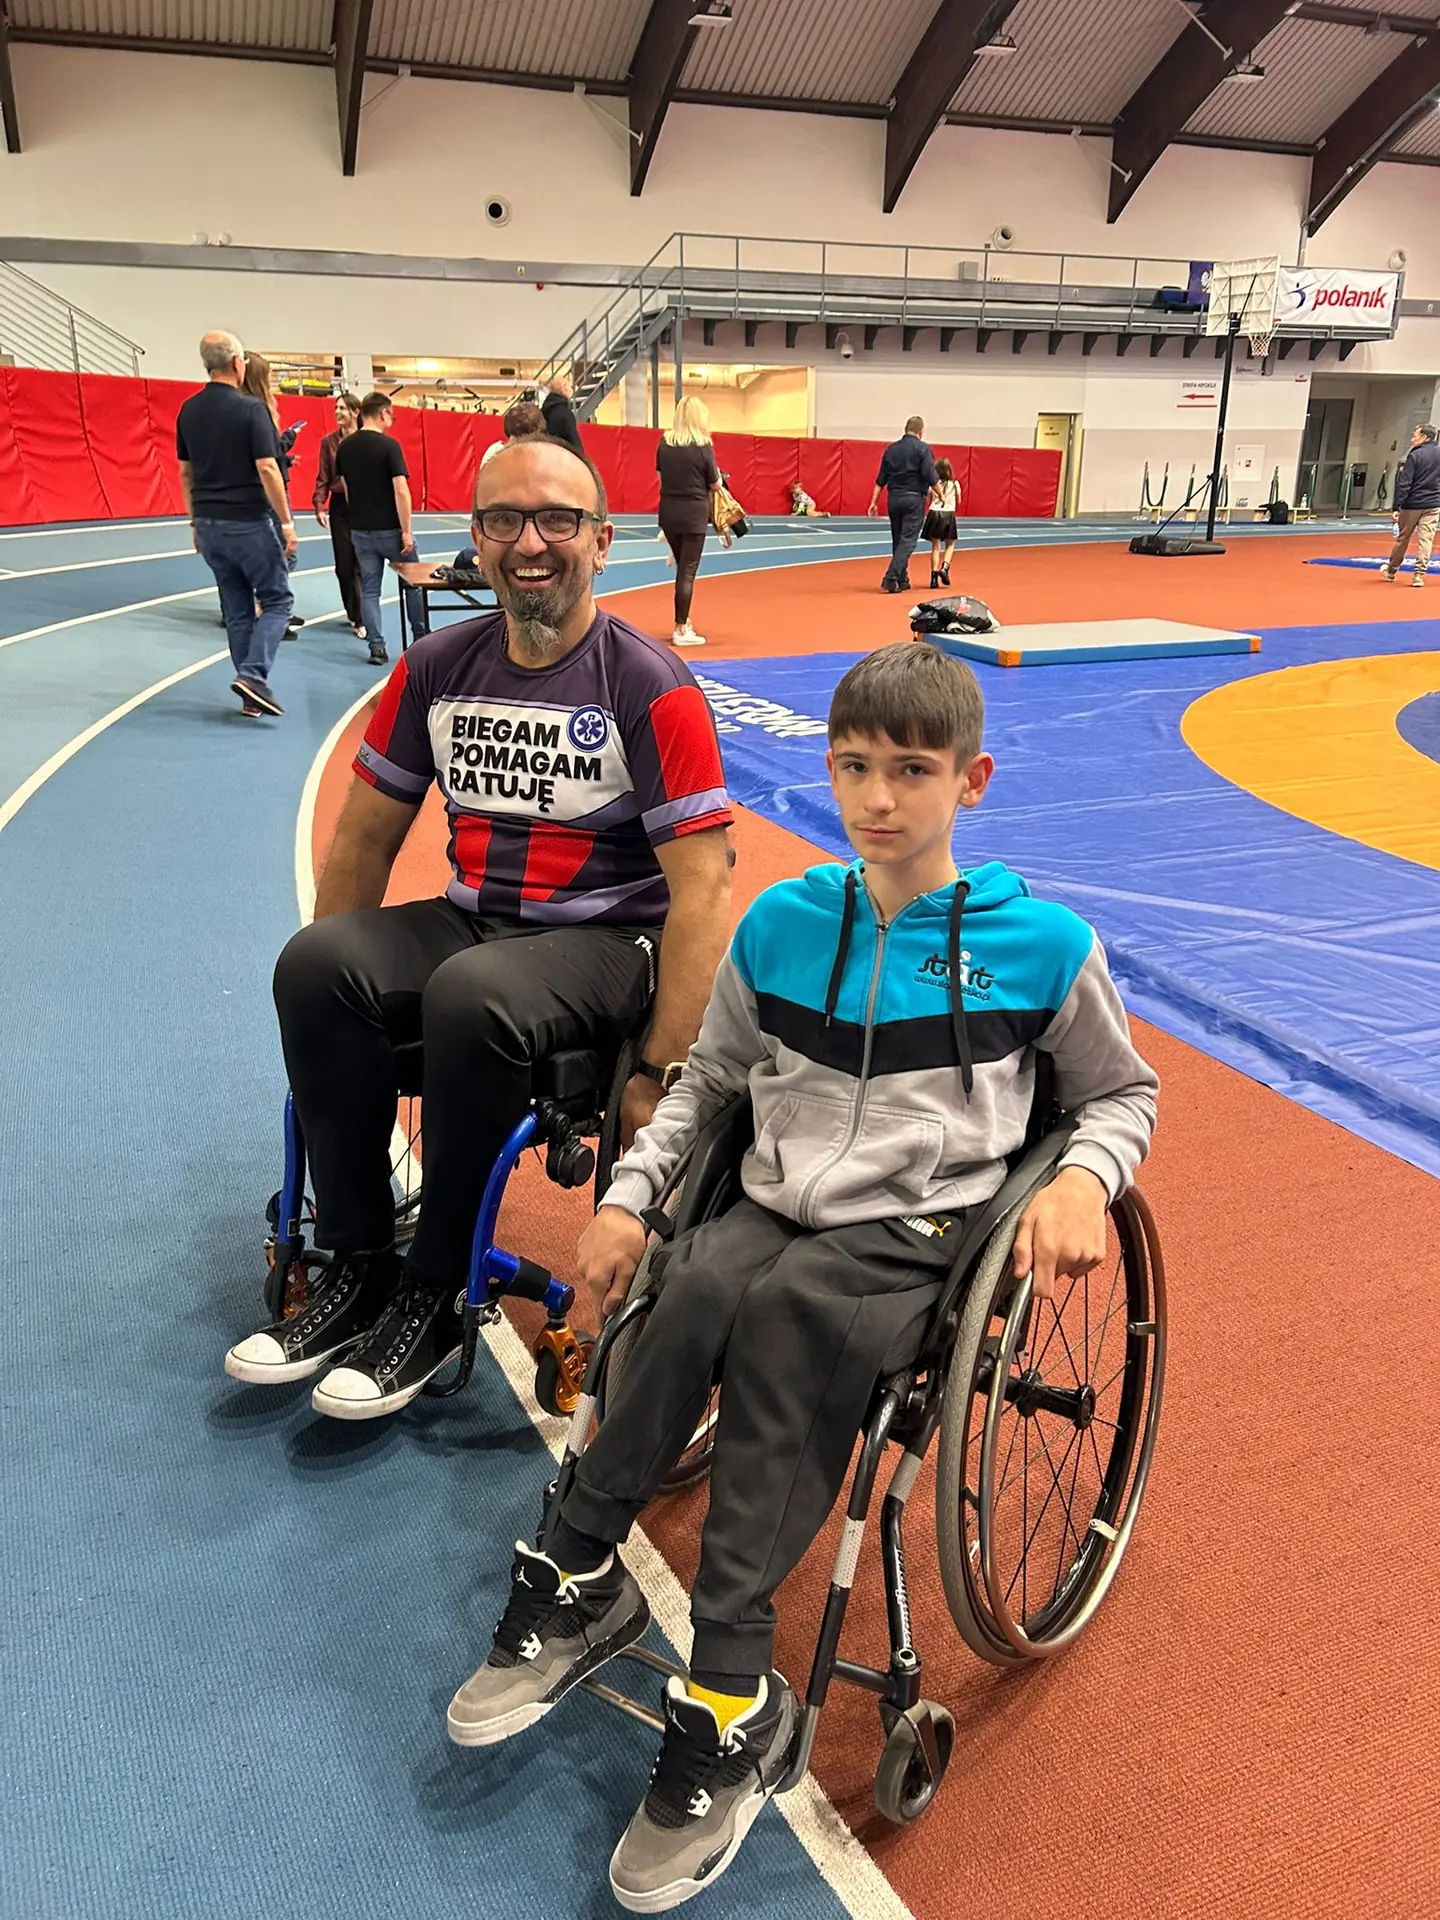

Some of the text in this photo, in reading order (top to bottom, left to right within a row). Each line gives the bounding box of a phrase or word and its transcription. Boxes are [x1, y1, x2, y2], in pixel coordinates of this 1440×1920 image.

[1311, 284, 1388, 311] polanik
[452, 715, 560, 748] BIEGAM
[450, 742, 602, 781] POMAGAM
[449, 767, 555, 813] RATUJĘ
